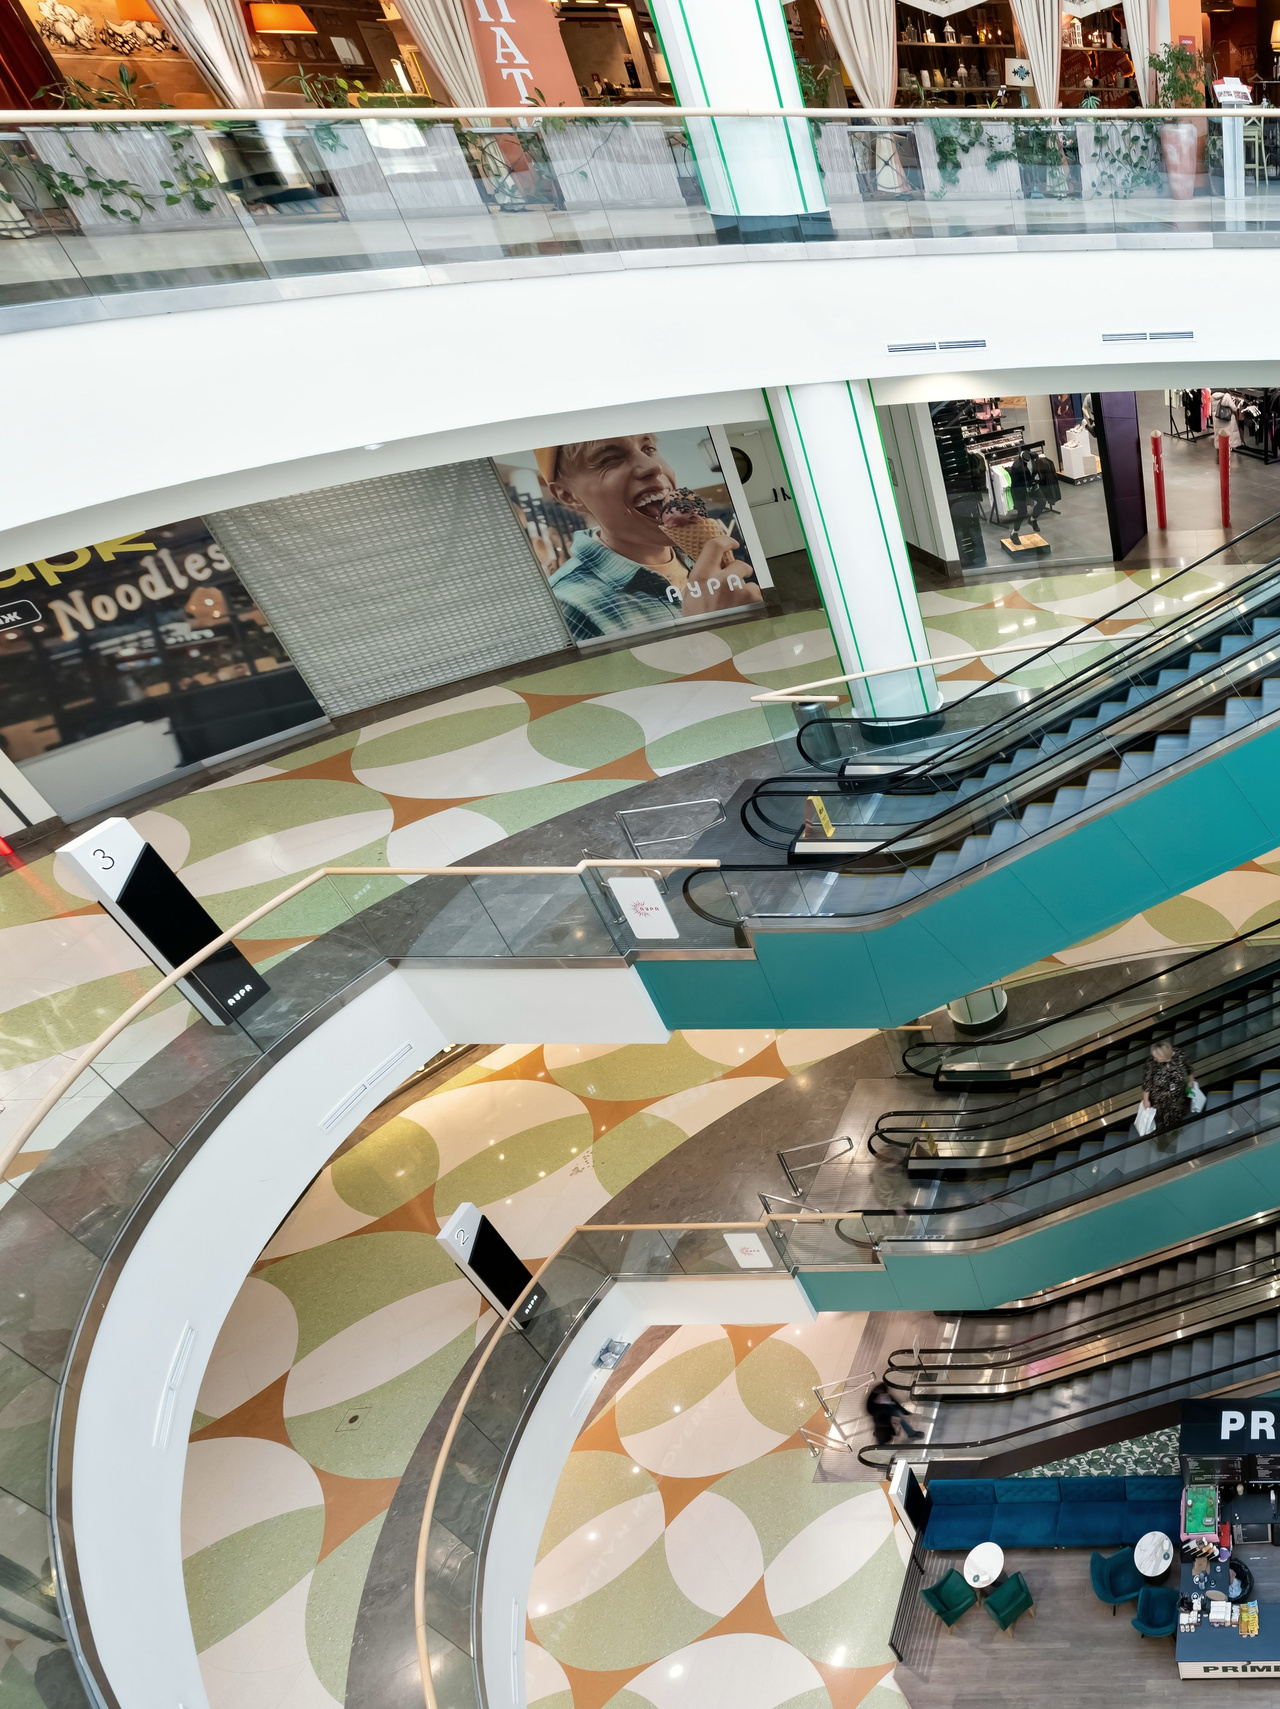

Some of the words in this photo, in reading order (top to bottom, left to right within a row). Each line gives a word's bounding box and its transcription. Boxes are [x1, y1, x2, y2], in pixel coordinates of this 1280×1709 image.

[48, 543, 235, 642] Noodles
[93, 848, 115, 870] 3
[455, 1228, 470, 1247] 2
